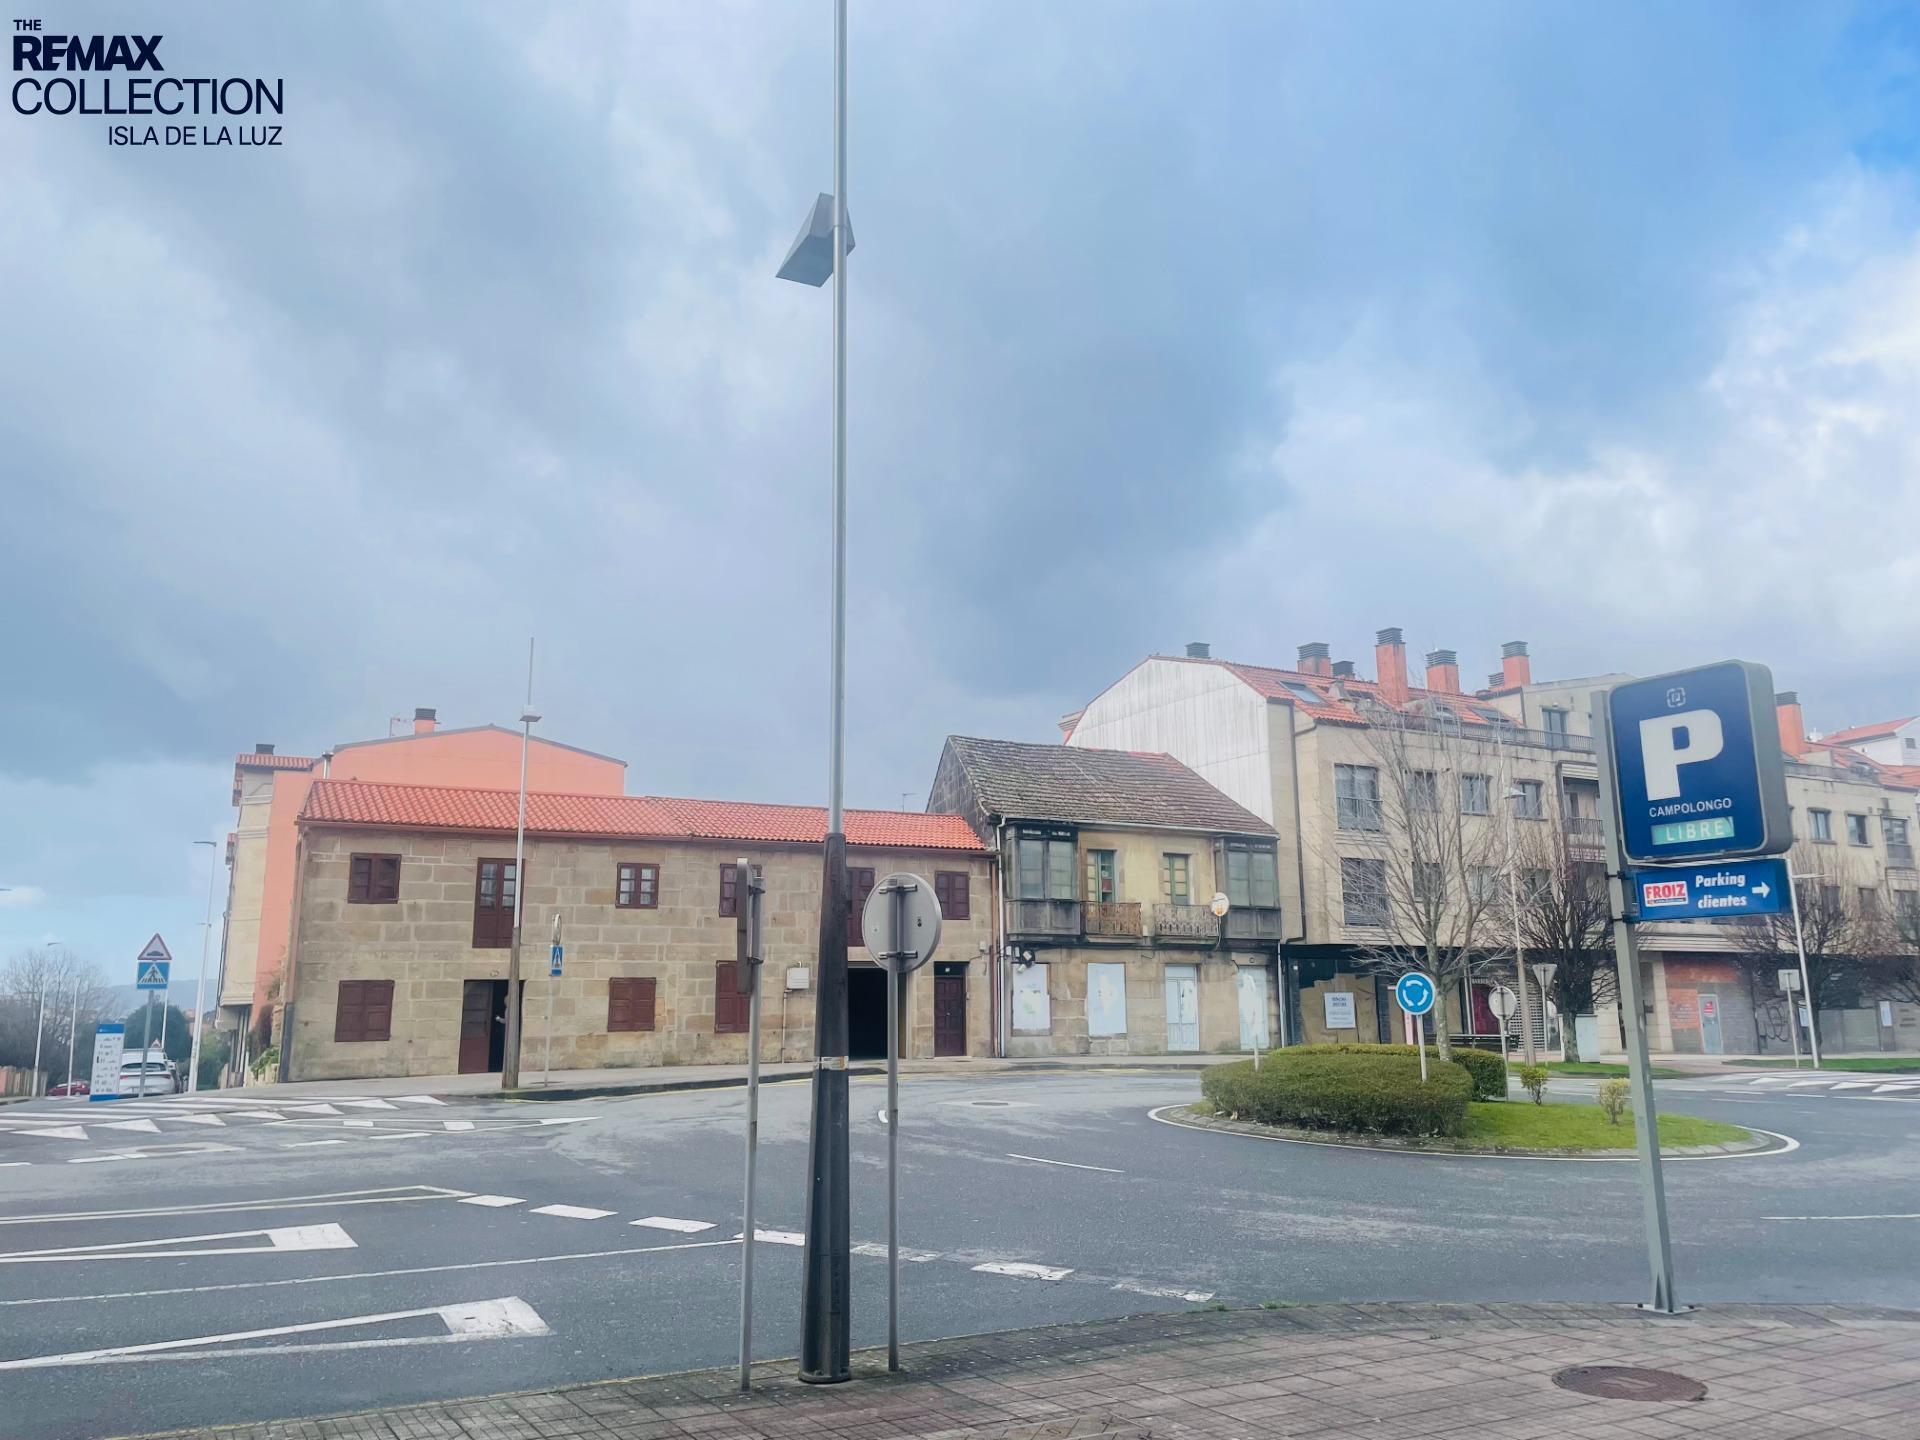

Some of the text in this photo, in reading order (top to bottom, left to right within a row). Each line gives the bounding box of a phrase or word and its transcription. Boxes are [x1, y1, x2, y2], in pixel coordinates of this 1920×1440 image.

[1639, 708, 1724, 801] P
[1649, 797, 1732, 818] CAMPOLONGO
[1665, 820, 1726, 842] LIBRE
[1696, 872, 1746, 888] Parking
[1645, 884, 1686, 899] FROIZ
[1697, 895, 1748, 909] clientes
